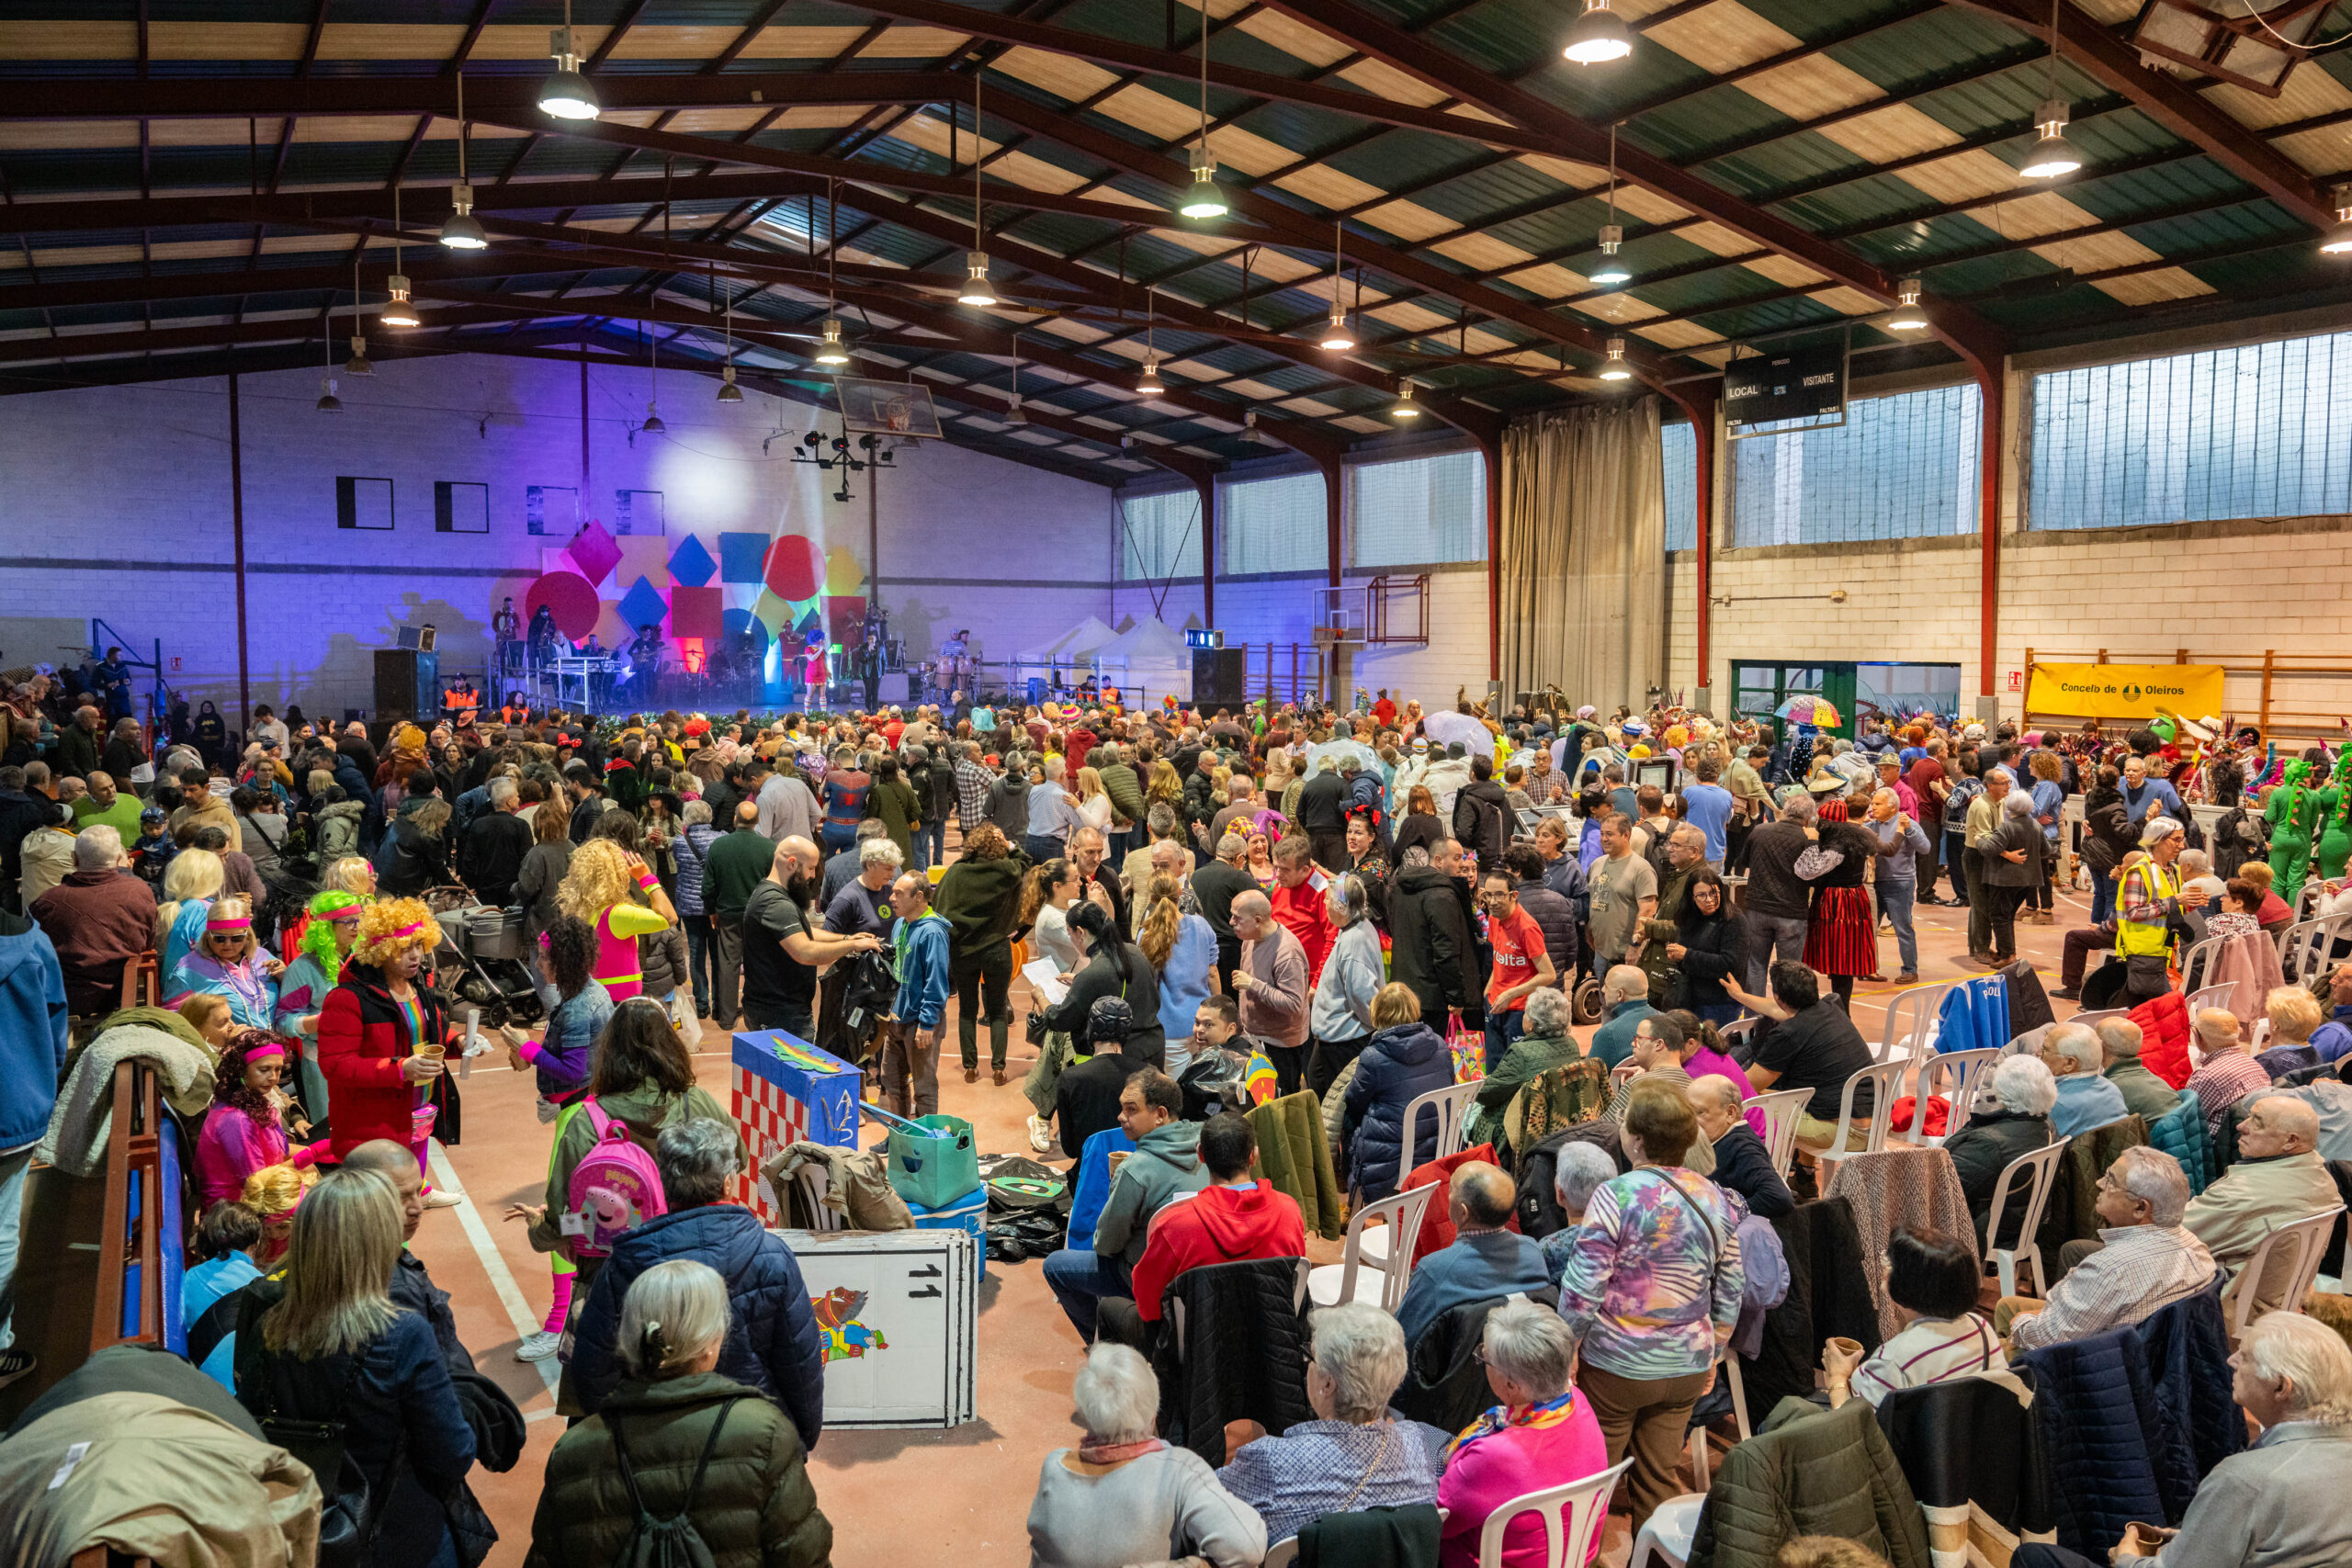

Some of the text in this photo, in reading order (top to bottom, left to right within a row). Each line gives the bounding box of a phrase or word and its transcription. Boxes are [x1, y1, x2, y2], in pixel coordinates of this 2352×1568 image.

[1803, 373, 1834, 387] VISITANTE
[1729, 385, 1758, 398] LOCAL
[2104, 684, 2117, 694] de
[2145, 685, 2184, 695] Oleiros
